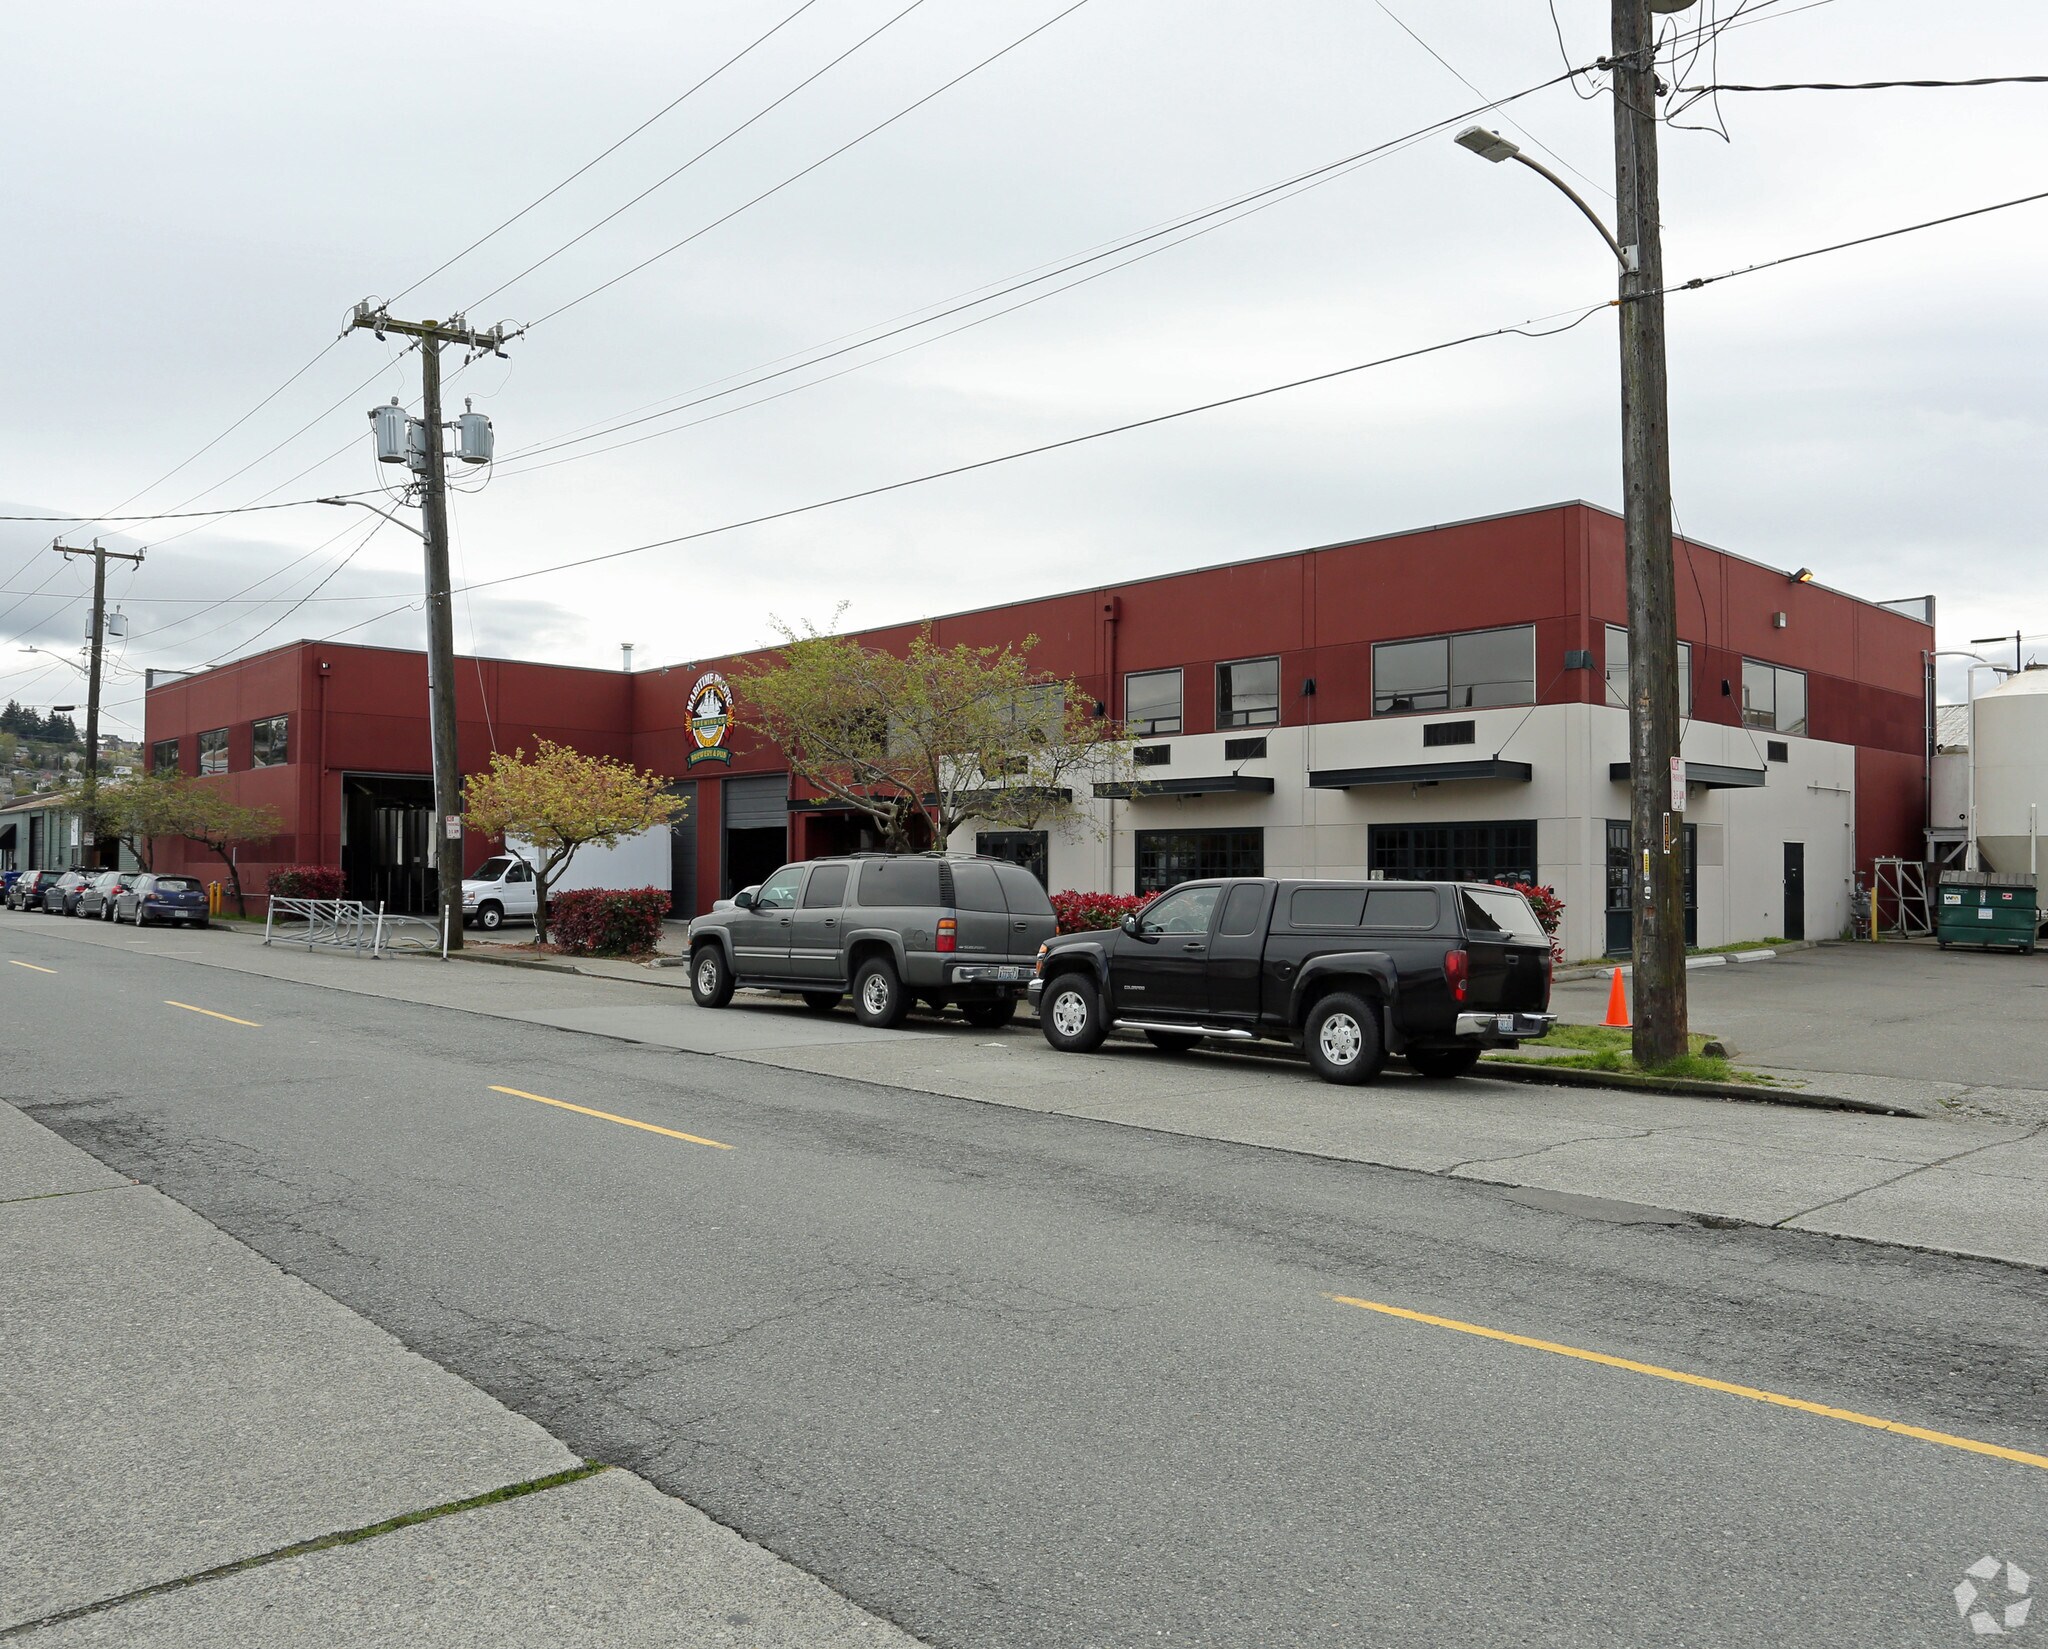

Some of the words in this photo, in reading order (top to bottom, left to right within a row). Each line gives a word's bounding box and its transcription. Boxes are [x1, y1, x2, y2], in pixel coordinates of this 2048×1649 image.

[687, 673, 715, 711] MARITIME
[693, 718, 717, 728] BREWING
[691, 750, 713, 762] BREWERY
[717, 750, 727, 759] PUB
